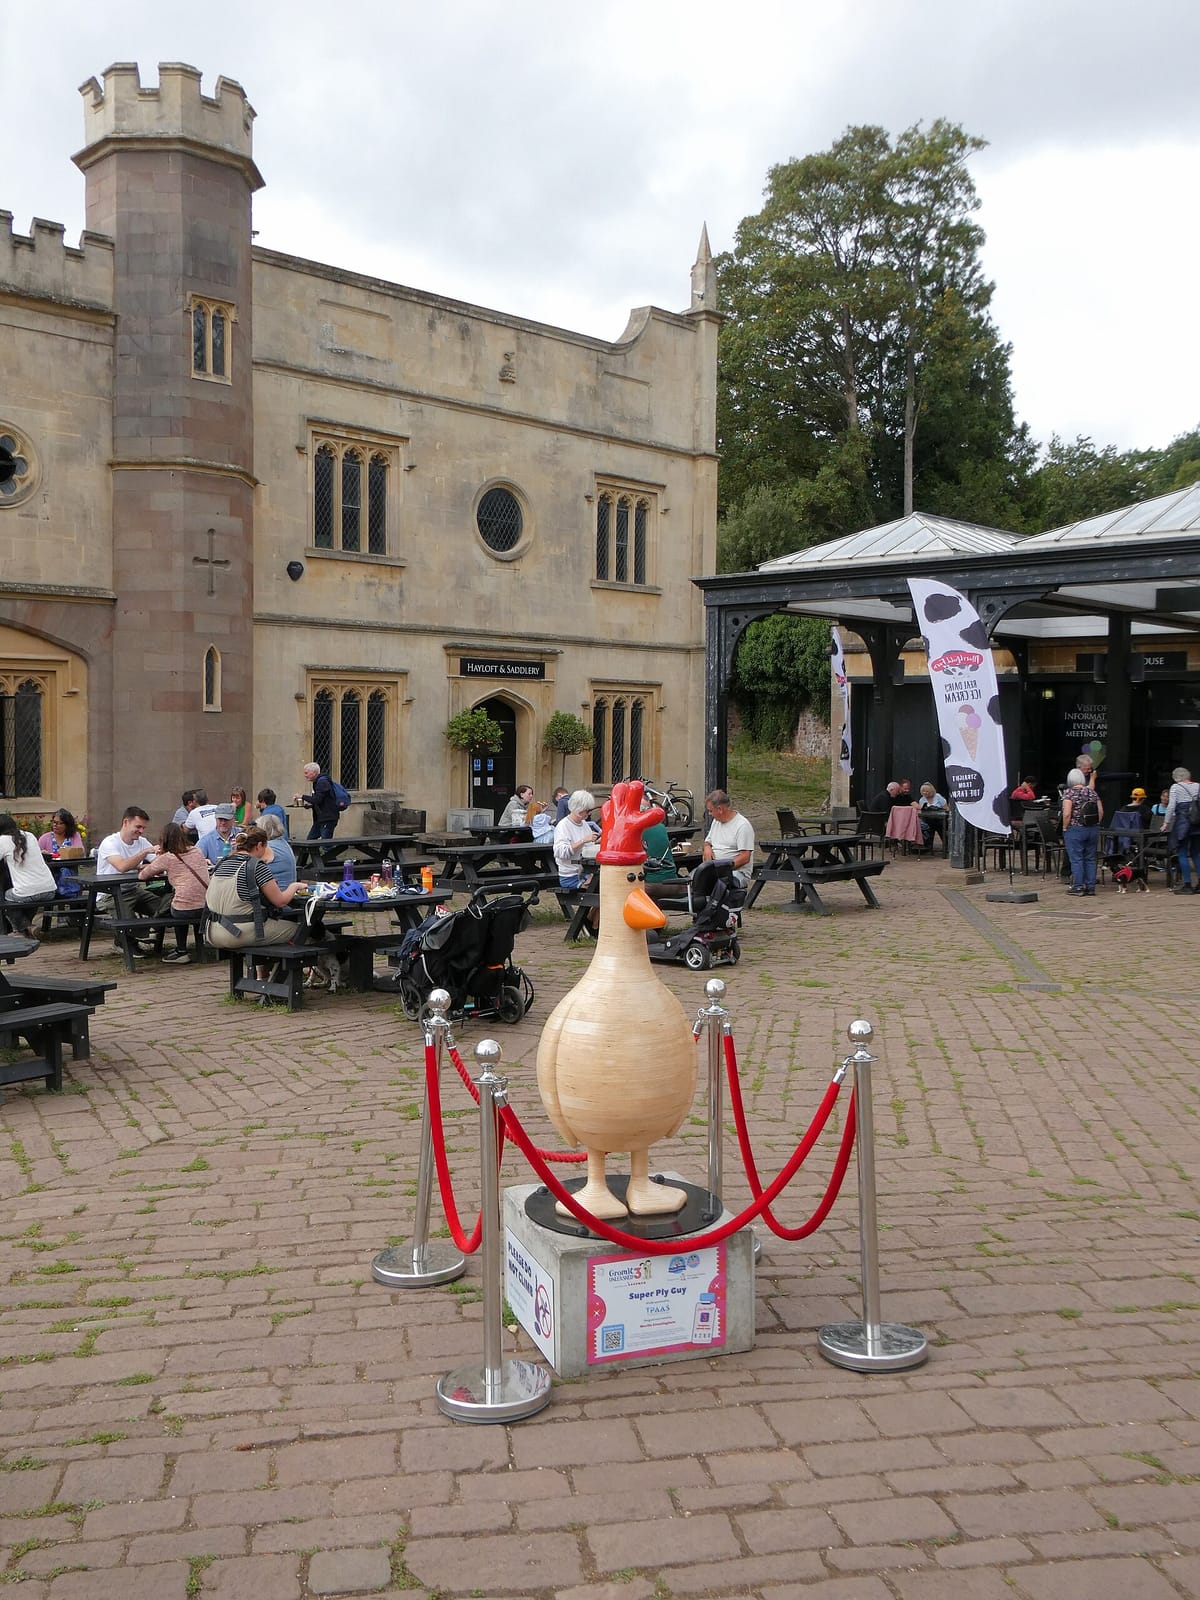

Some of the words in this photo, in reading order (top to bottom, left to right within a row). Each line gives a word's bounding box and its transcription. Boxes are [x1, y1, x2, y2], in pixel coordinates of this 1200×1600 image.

[467, 663, 499, 673] HAYLOFT
[500, 664, 505, 674] &
[507, 665, 540, 675] SADDLERY
[1072, 722, 1096, 730] EVENT
[508, 1241, 524, 1269] PLEASE
[524, 1261, 532, 1277] DO
[508, 1259, 518, 1278] NOT
[518, 1272, 533, 1297] CLIMB
[633, 1267, 642, 1279] 3
[629, 1291, 654, 1301] Super
[655, 1288, 669, 1297] Ply
[670, 1287, 687, 1296] Guy
